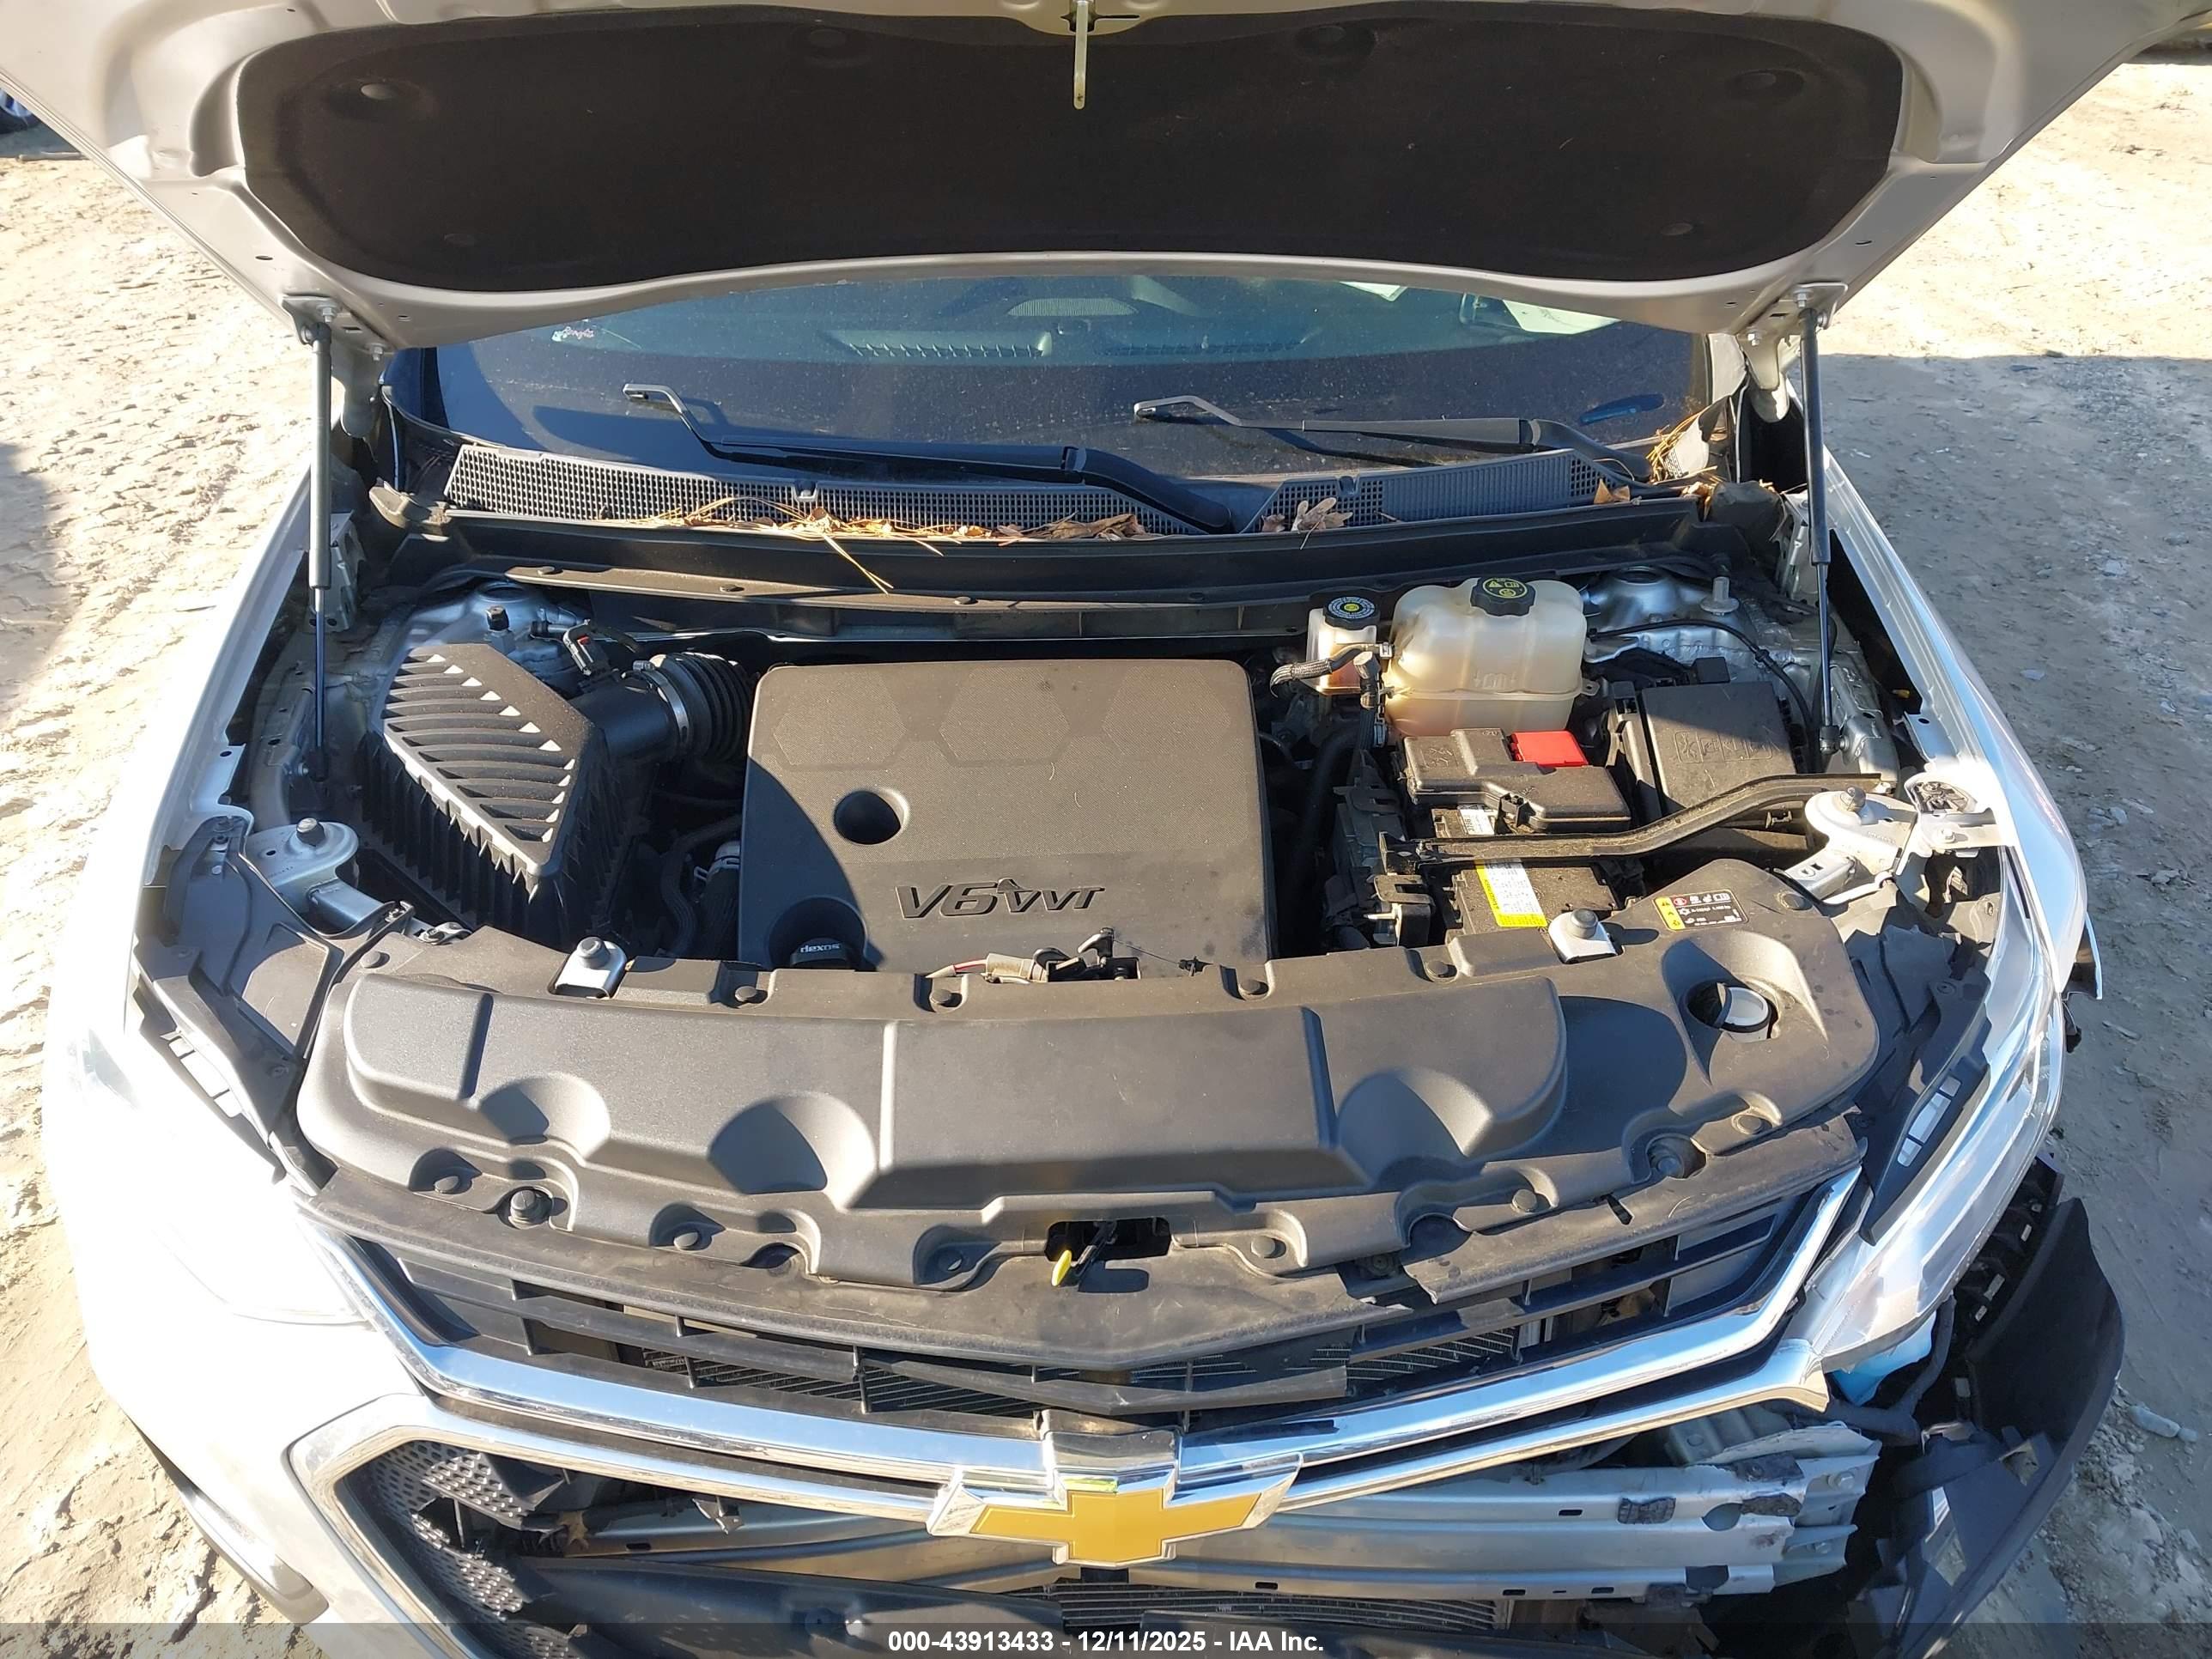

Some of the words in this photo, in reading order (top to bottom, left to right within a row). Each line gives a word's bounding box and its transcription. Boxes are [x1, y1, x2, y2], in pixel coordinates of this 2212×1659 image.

[896, 881, 998, 920] V6
[1000, 884, 1106, 914] VVT
[799, 944, 840, 953] dexos
